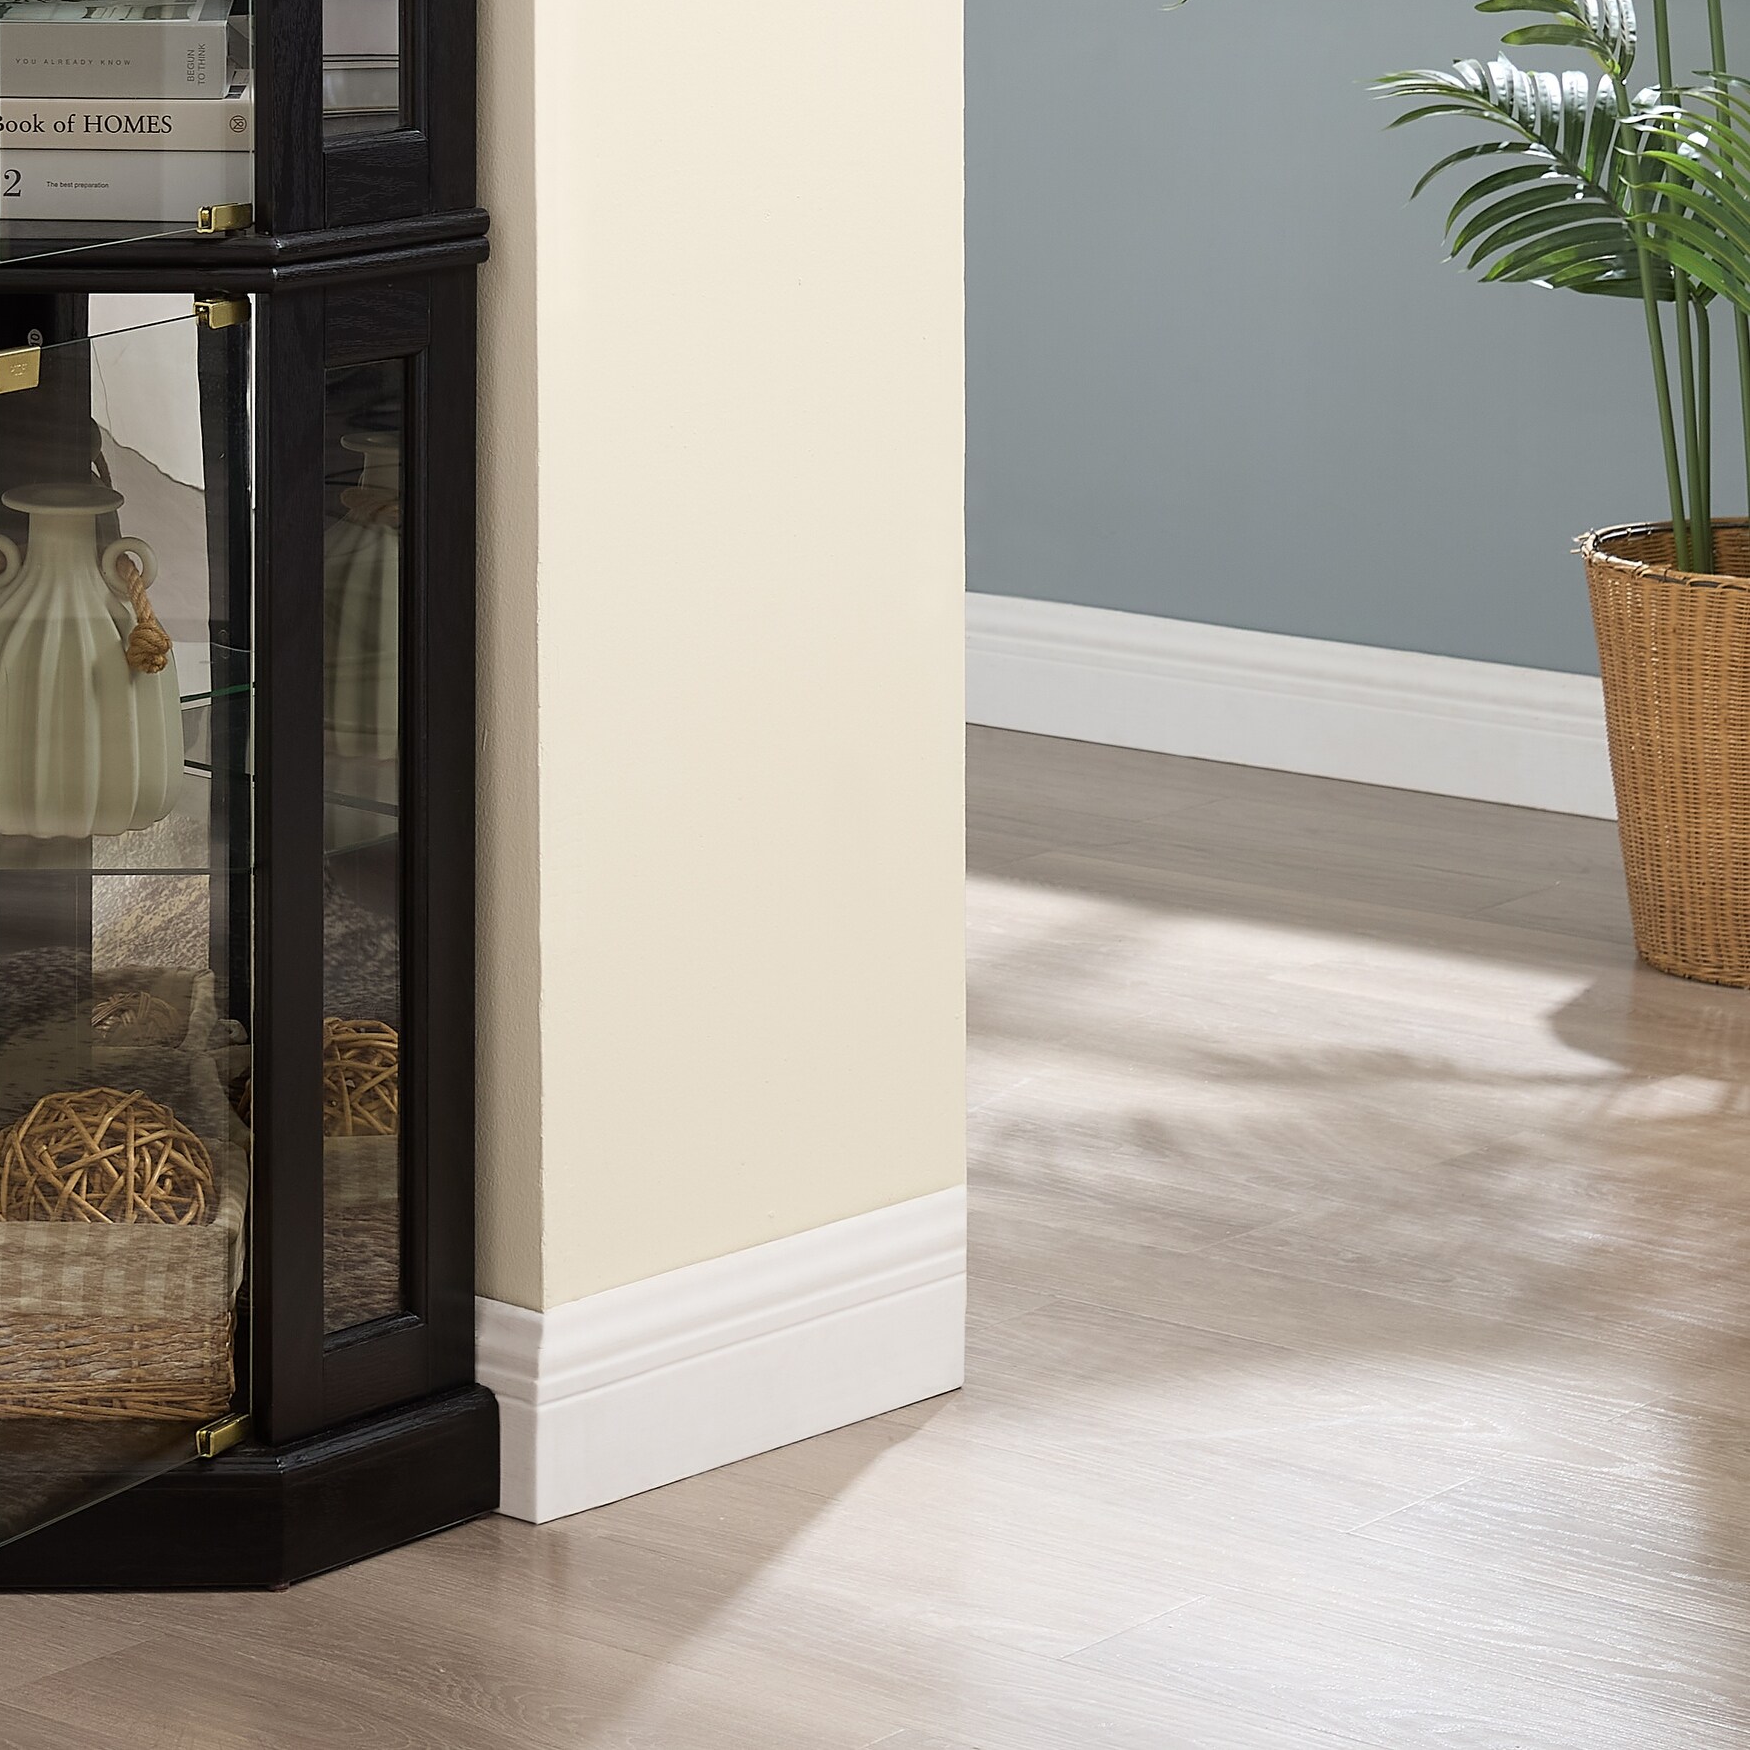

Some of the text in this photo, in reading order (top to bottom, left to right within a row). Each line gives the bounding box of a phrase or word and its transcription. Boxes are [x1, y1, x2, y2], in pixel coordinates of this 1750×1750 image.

[43, 58, 93, 66] ALREADY
[187, 49, 195, 82] BEGUN
[198, 43, 206, 85] TO THINK
[53, 113, 76, 133] of
[83, 114, 173, 134] HOMES
